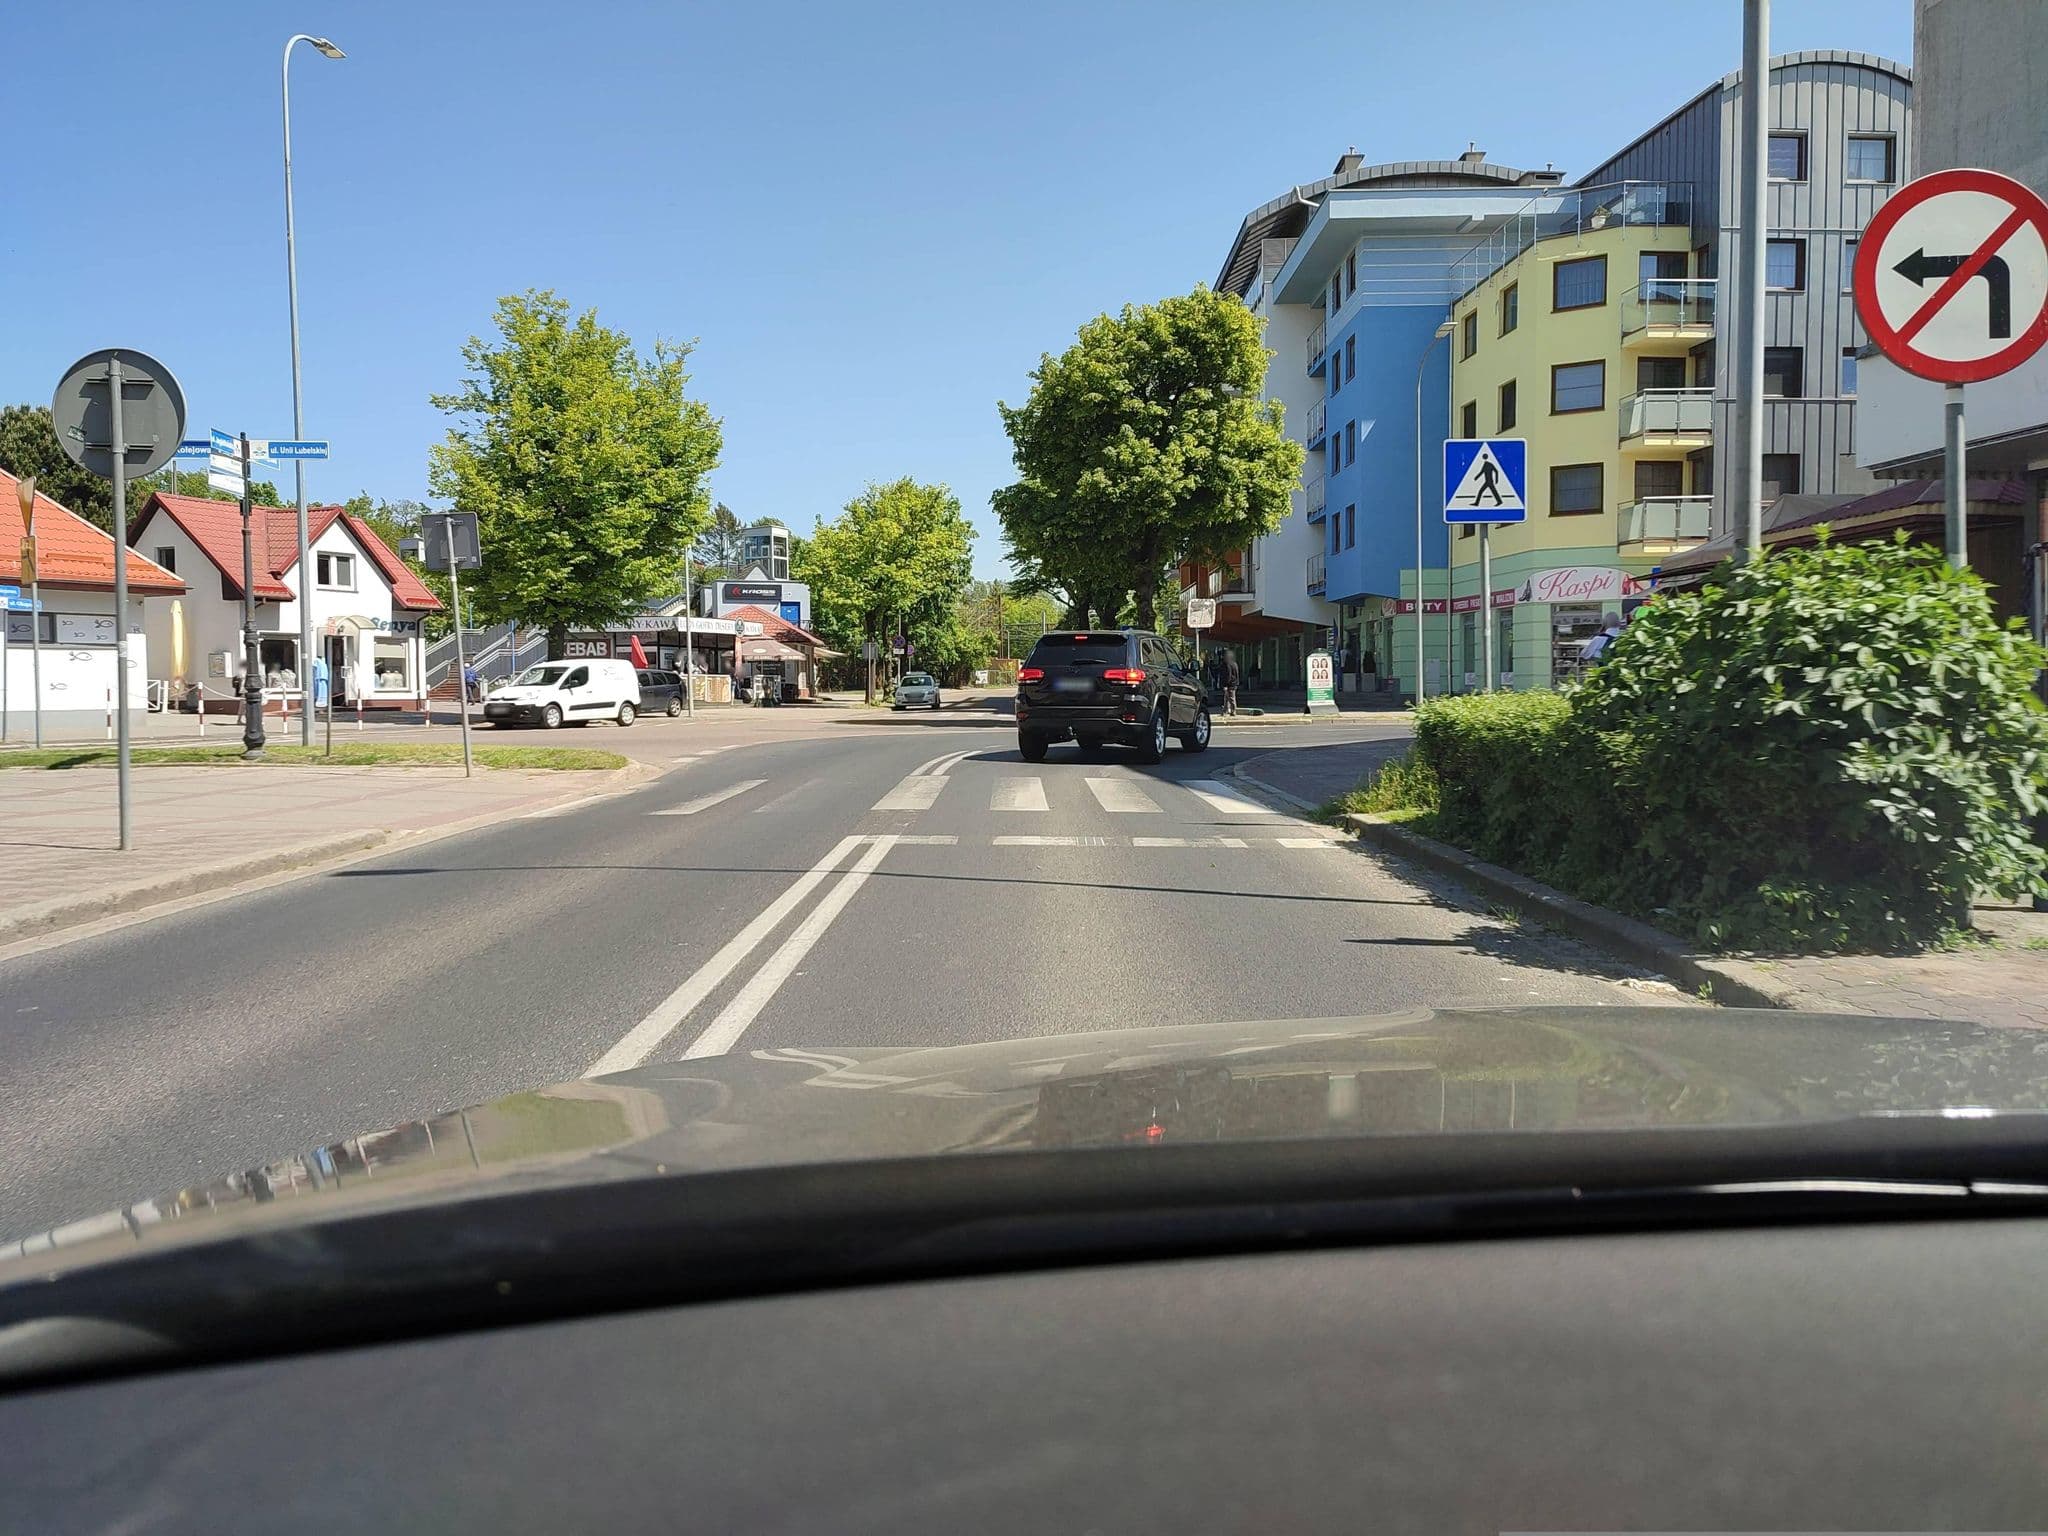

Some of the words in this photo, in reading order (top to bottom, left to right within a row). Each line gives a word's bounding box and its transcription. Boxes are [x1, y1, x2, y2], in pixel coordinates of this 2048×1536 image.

[270, 446, 279, 454] ul.
[280, 446, 293, 454] Unii
[1538, 569, 1617, 601] Kaspi
